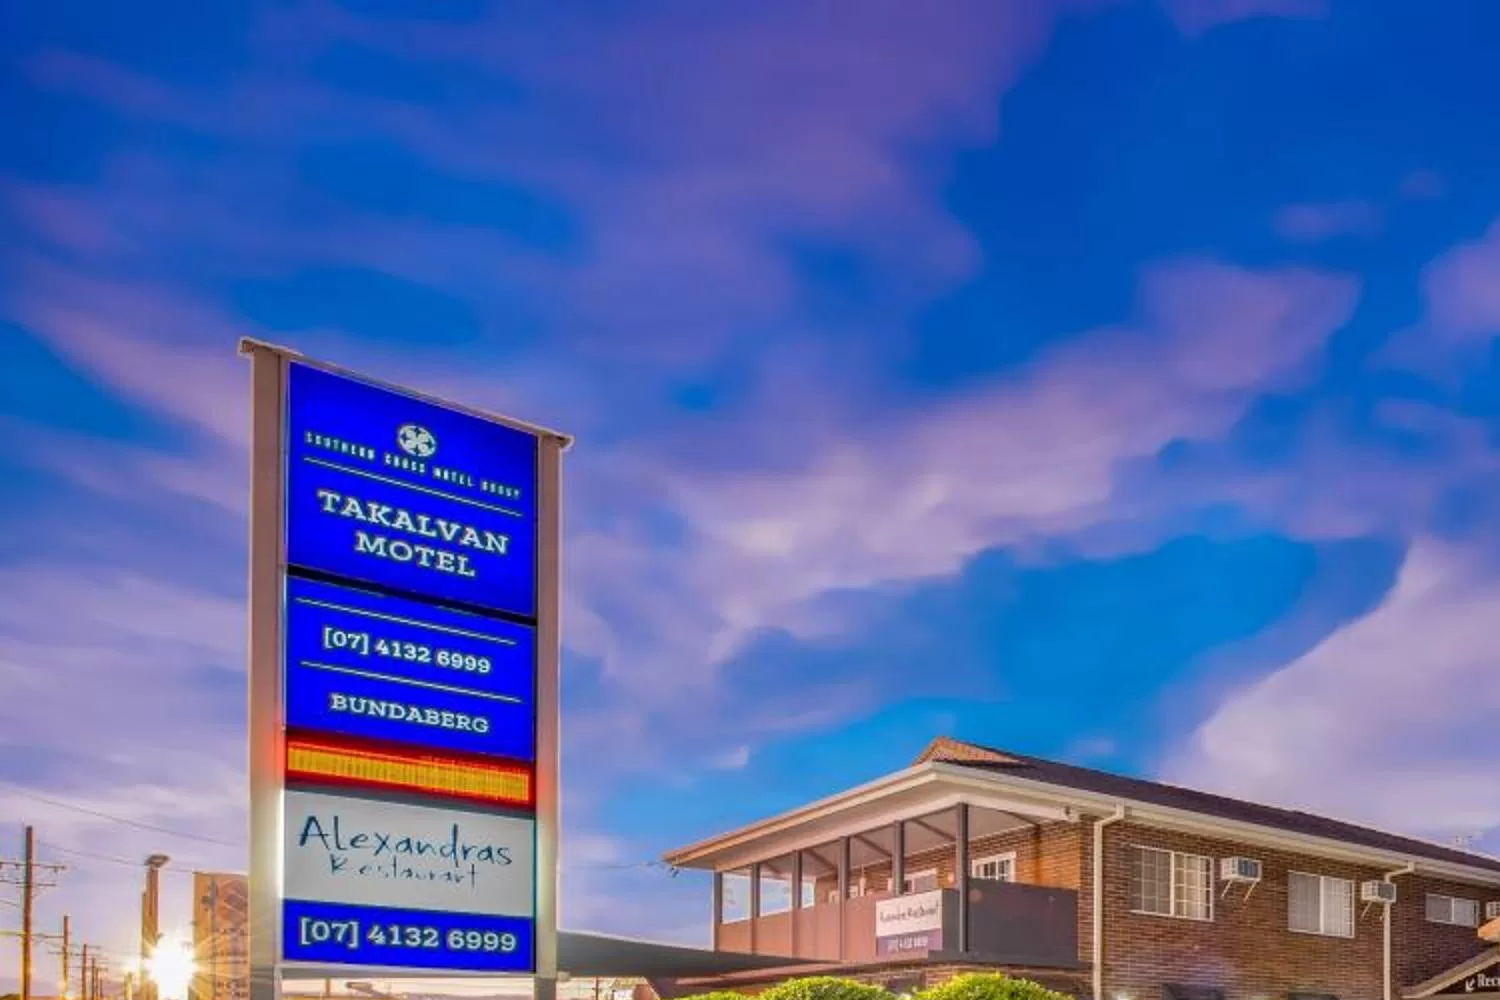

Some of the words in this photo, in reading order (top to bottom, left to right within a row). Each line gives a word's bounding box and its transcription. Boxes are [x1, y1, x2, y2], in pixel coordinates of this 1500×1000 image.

[317, 489, 509, 554] TAKALVAN
[355, 531, 476, 577] MOTEL
[324, 627, 370, 655] [07]
[375, 639, 432, 663] 4132
[436, 650, 491, 674] 6999
[330, 692, 489, 733] BUNDABERG
[298, 815, 512, 867] Alexandras
[300, 916, 360, 948] [07]
[367, 924, 439, 948] 4132
[447, 929, 517, 951] 6999
